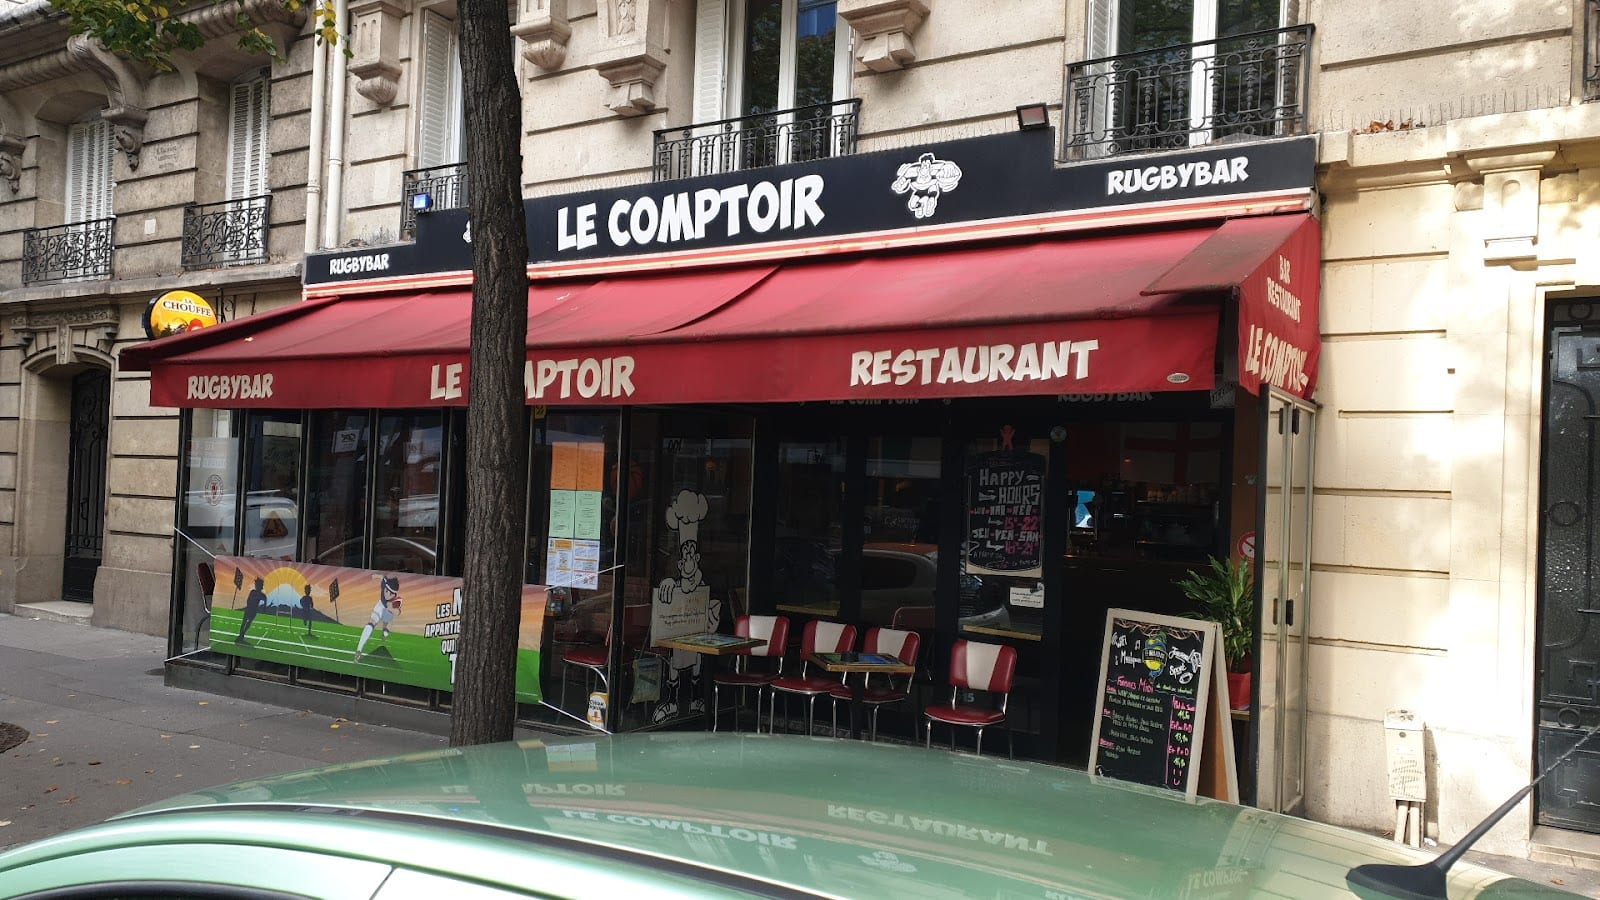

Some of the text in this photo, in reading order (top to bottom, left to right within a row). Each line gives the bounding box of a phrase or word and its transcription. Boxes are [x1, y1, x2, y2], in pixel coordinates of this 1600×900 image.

[1107, 156, 1249, 196] RUGBYBAR
[557, 174, 825, 252] LE COMPTOIR
[329, 253, 390, 276] RUGBYBAR
[1279, 254, 1291, 285] BAR
[163, 301, 212, 317] CHOUFFE
[1267, 277, 1302, 323] RESTAURANT
[850, 339, 1099, 387] RESTAURANT
[1246, 324, 1264, 375] LE
[187, 373, 275, 400] RUGBYBAR
[430, 363, 463, 401] LE
[998, 484, 1041, 506] HOURS
[436, 604, 451, 619] LES
[441, 639, 455, 655] QUI
